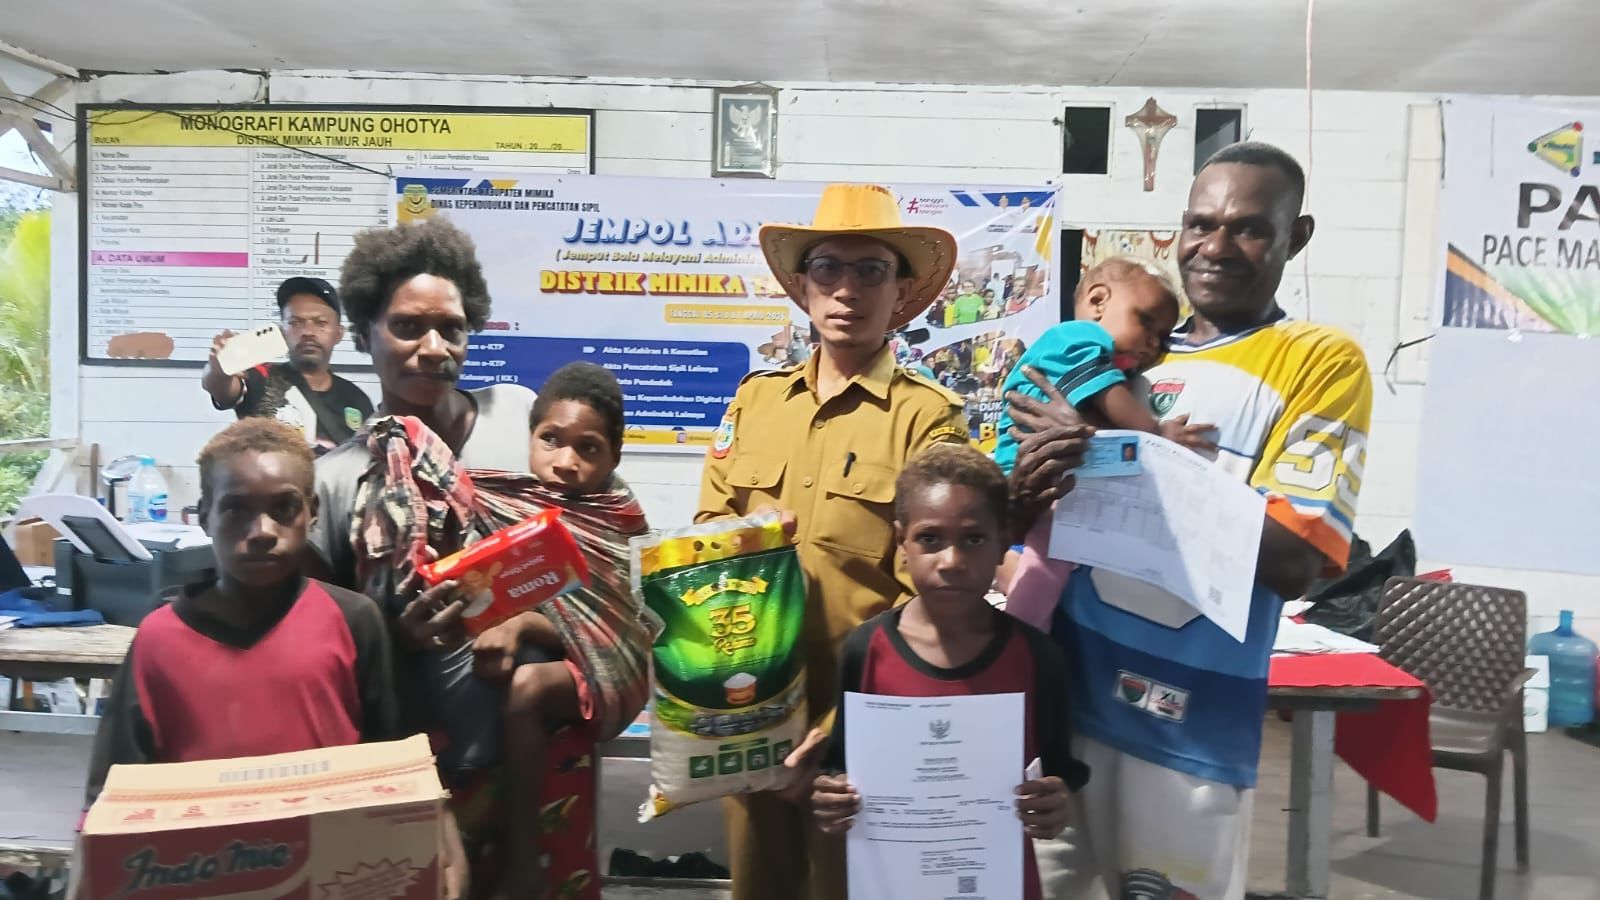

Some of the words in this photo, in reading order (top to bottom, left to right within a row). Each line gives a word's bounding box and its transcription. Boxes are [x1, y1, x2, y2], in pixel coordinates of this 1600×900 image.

[180, 115, 283, 133] MONOGRAFI
[287, 116, 374, 134] KAMPUNG
[380, 118, 452, 134] OHOTYA
[94, 136, 121, 144] BULAN
[236, 135, 279, 146] DISTRIK
[283, 136, 321, 147] MIMIKA
[325, 136, 359, 147] TIMUR
[362, 136, 393, 148] JAUH
[431, 188, 476, 196] PEMERINTAH
[478, 188, 522, 198] KABUPATEN
[525, 189, 554, 198] MIMIKA
[431, 199, 453, 209] DINAS
[455, 200, 512, 210] KEPENDUDUKAN
[514, 200, 530, 210] DAN
[532, 201, 579, 212] PENCATATAN
[581, 203, 601, 212] SIPIL
[563, 217, 692, 246] JEMPOL
[1482, 234, 1548, 267] PACE
[108, 254, 133, 262] DATA
[562, 250, 610, 264] Jemput
[611, 252, 641, 262] Bola
[641, 251, 702, 266] Melayani
[539, 269, 647, 296] DISTRIK
[647, 272, 749, 298] MIMIKA
[623, 346, 661, 355] Kelahiran
[670, 348, 709, 356] Kematian
[623, 363, 668, 371] Pencatatan
[633, 378, 673, 386] Penduduk
[695, 395, 722, 404] Digital
[635, 410, 674, 418] Adminduk
[507, 570, 561, 599] Roma
[709, 603, 757, 638] 35
